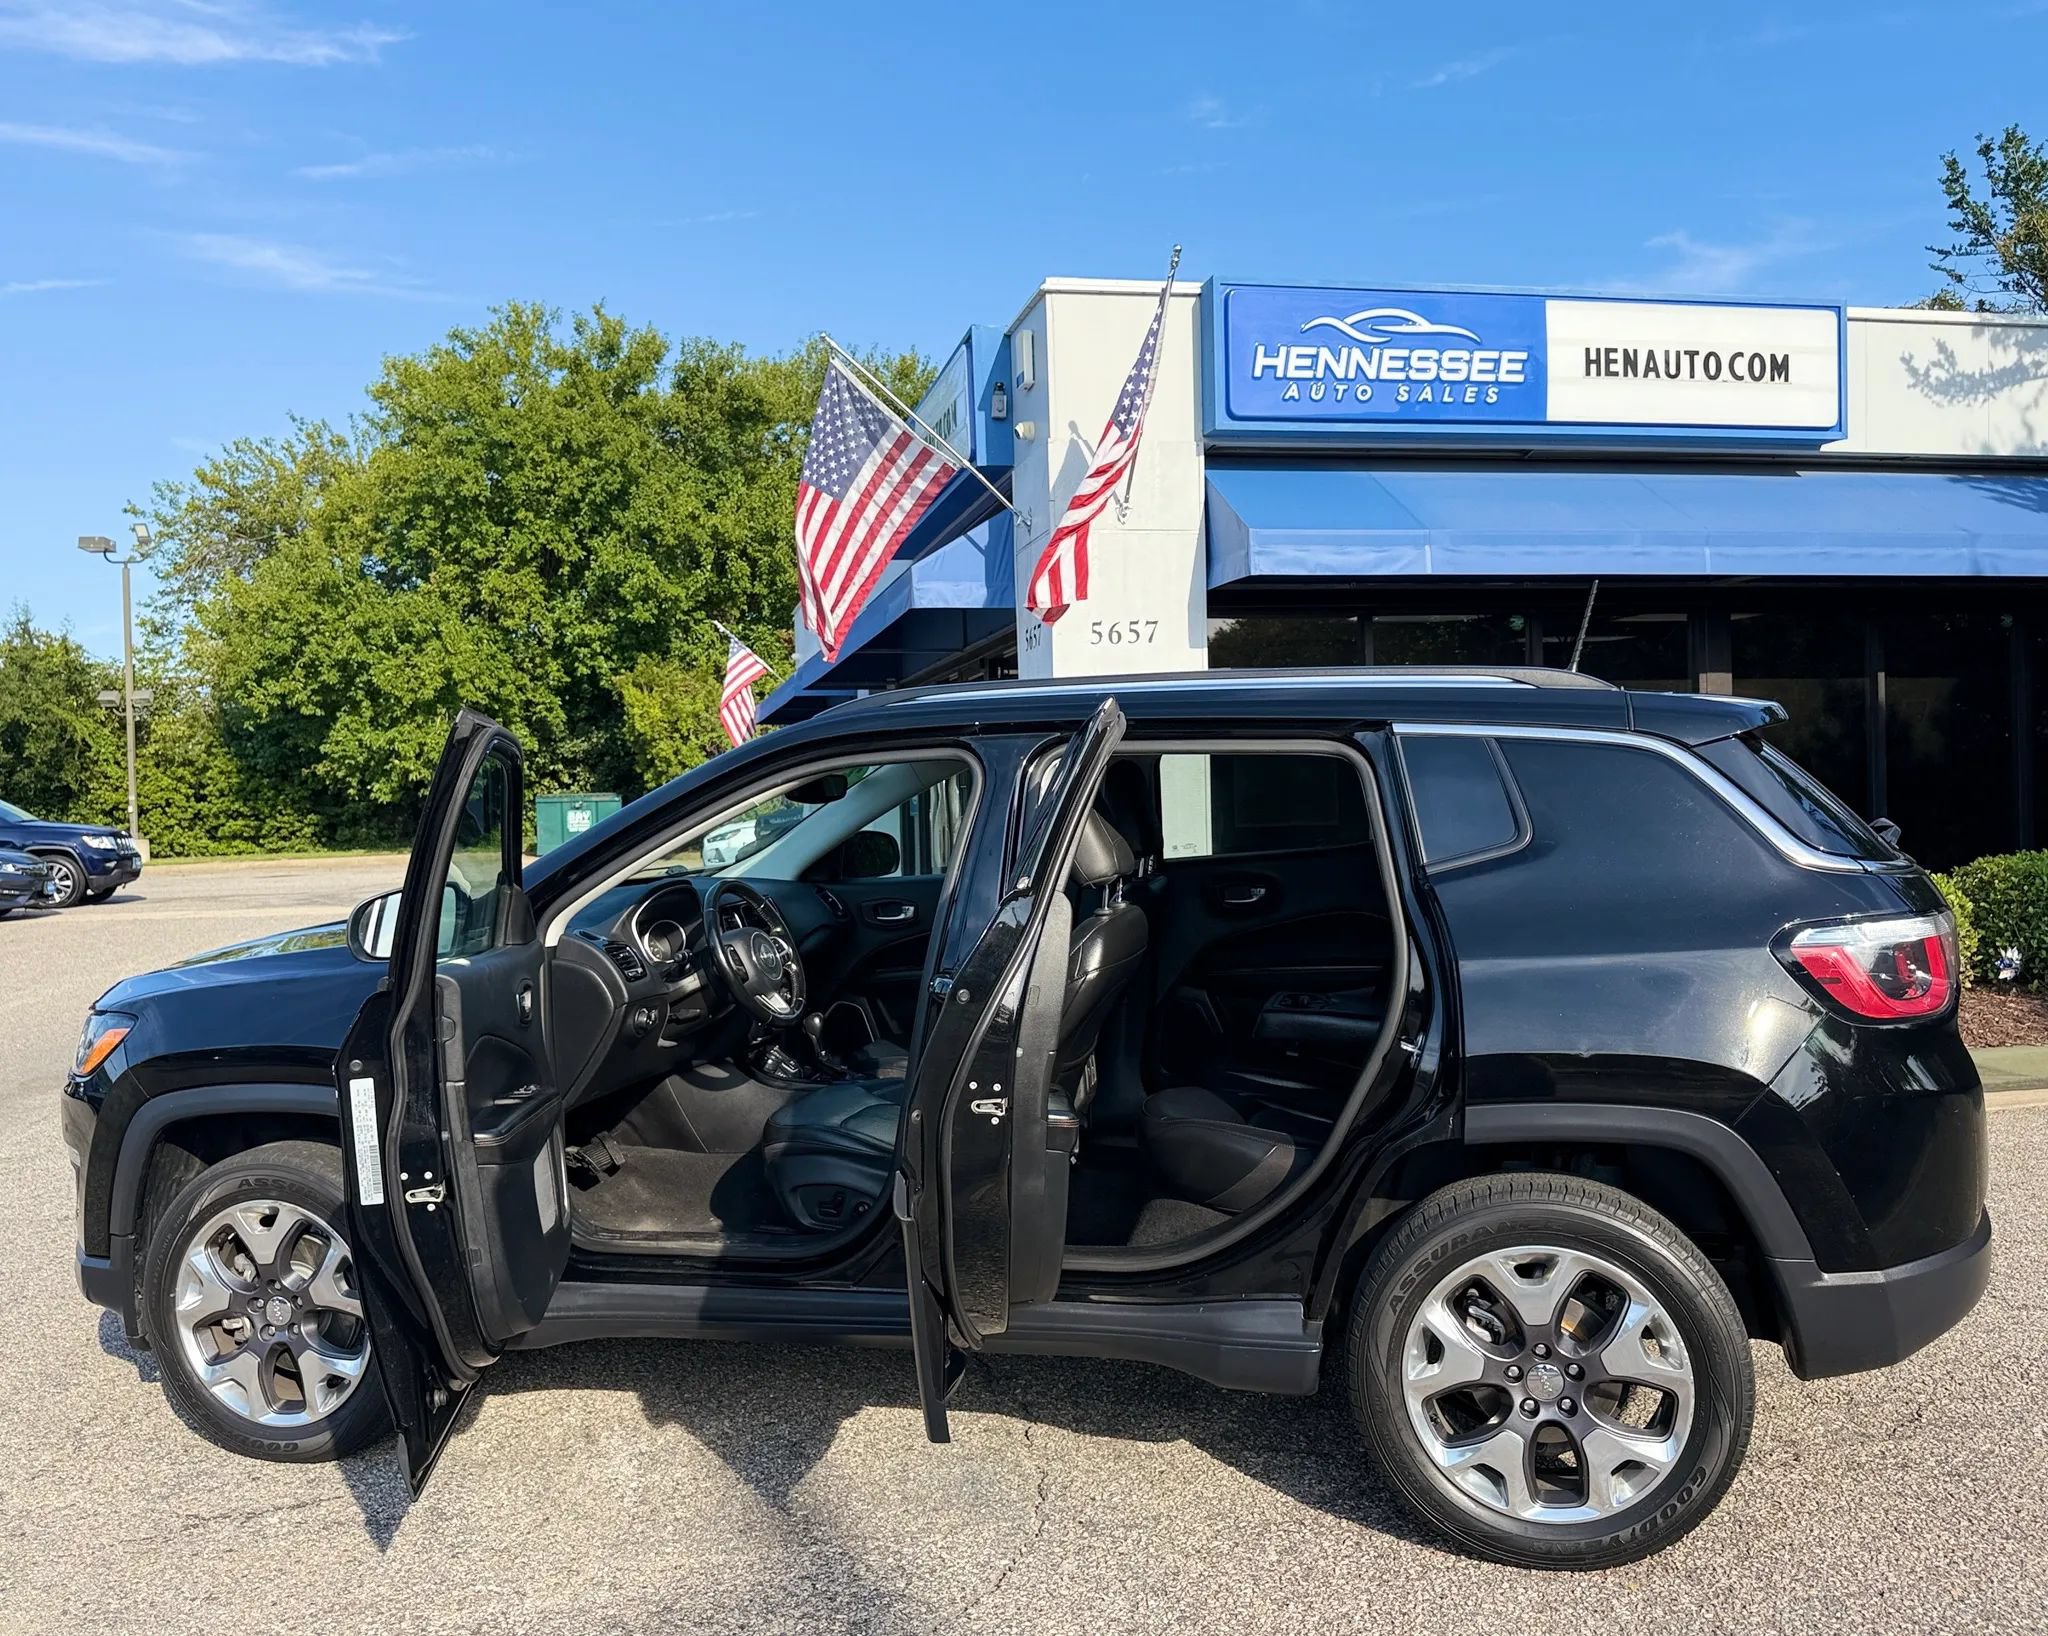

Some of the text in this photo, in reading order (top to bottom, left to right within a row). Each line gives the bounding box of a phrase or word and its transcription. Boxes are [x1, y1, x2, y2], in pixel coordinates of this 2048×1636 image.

[1253, 344, 1528, 382] HENNESSEE
[1283, 382, 1500, 404] AUTO SALES
[1090, 620, 1159, 645] 5657
